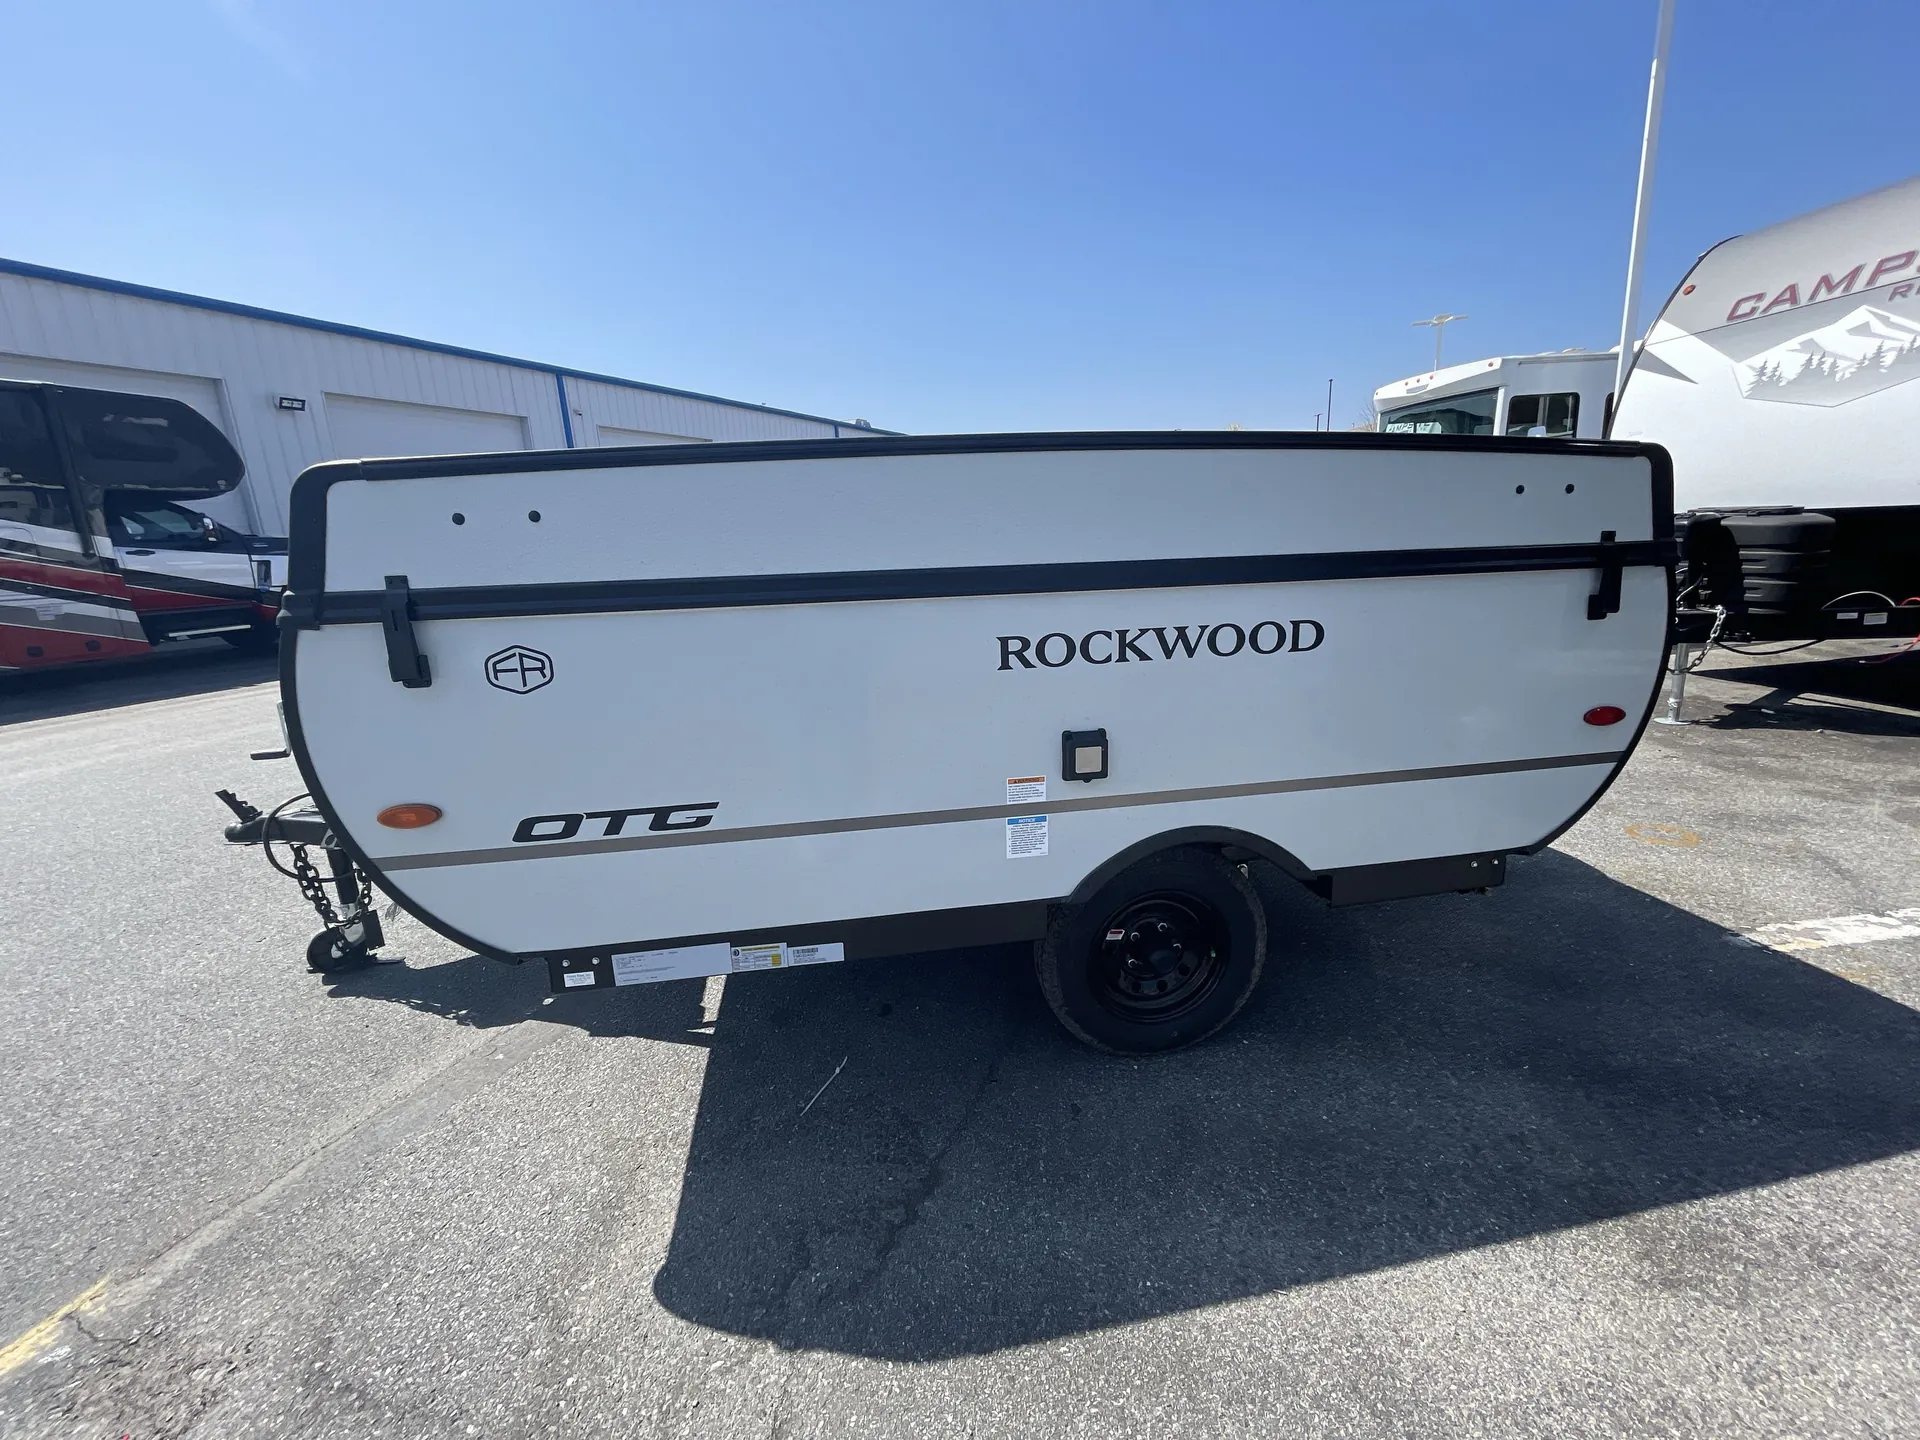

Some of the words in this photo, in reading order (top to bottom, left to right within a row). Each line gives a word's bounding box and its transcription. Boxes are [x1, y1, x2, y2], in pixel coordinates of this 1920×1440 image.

[1725, 248, 1920, 323] CAMP
[996, 619, 1325, 671] ROCKWOOD
[491, 651, 548, 689] FR
[511, 801, 720, 843] OTG
